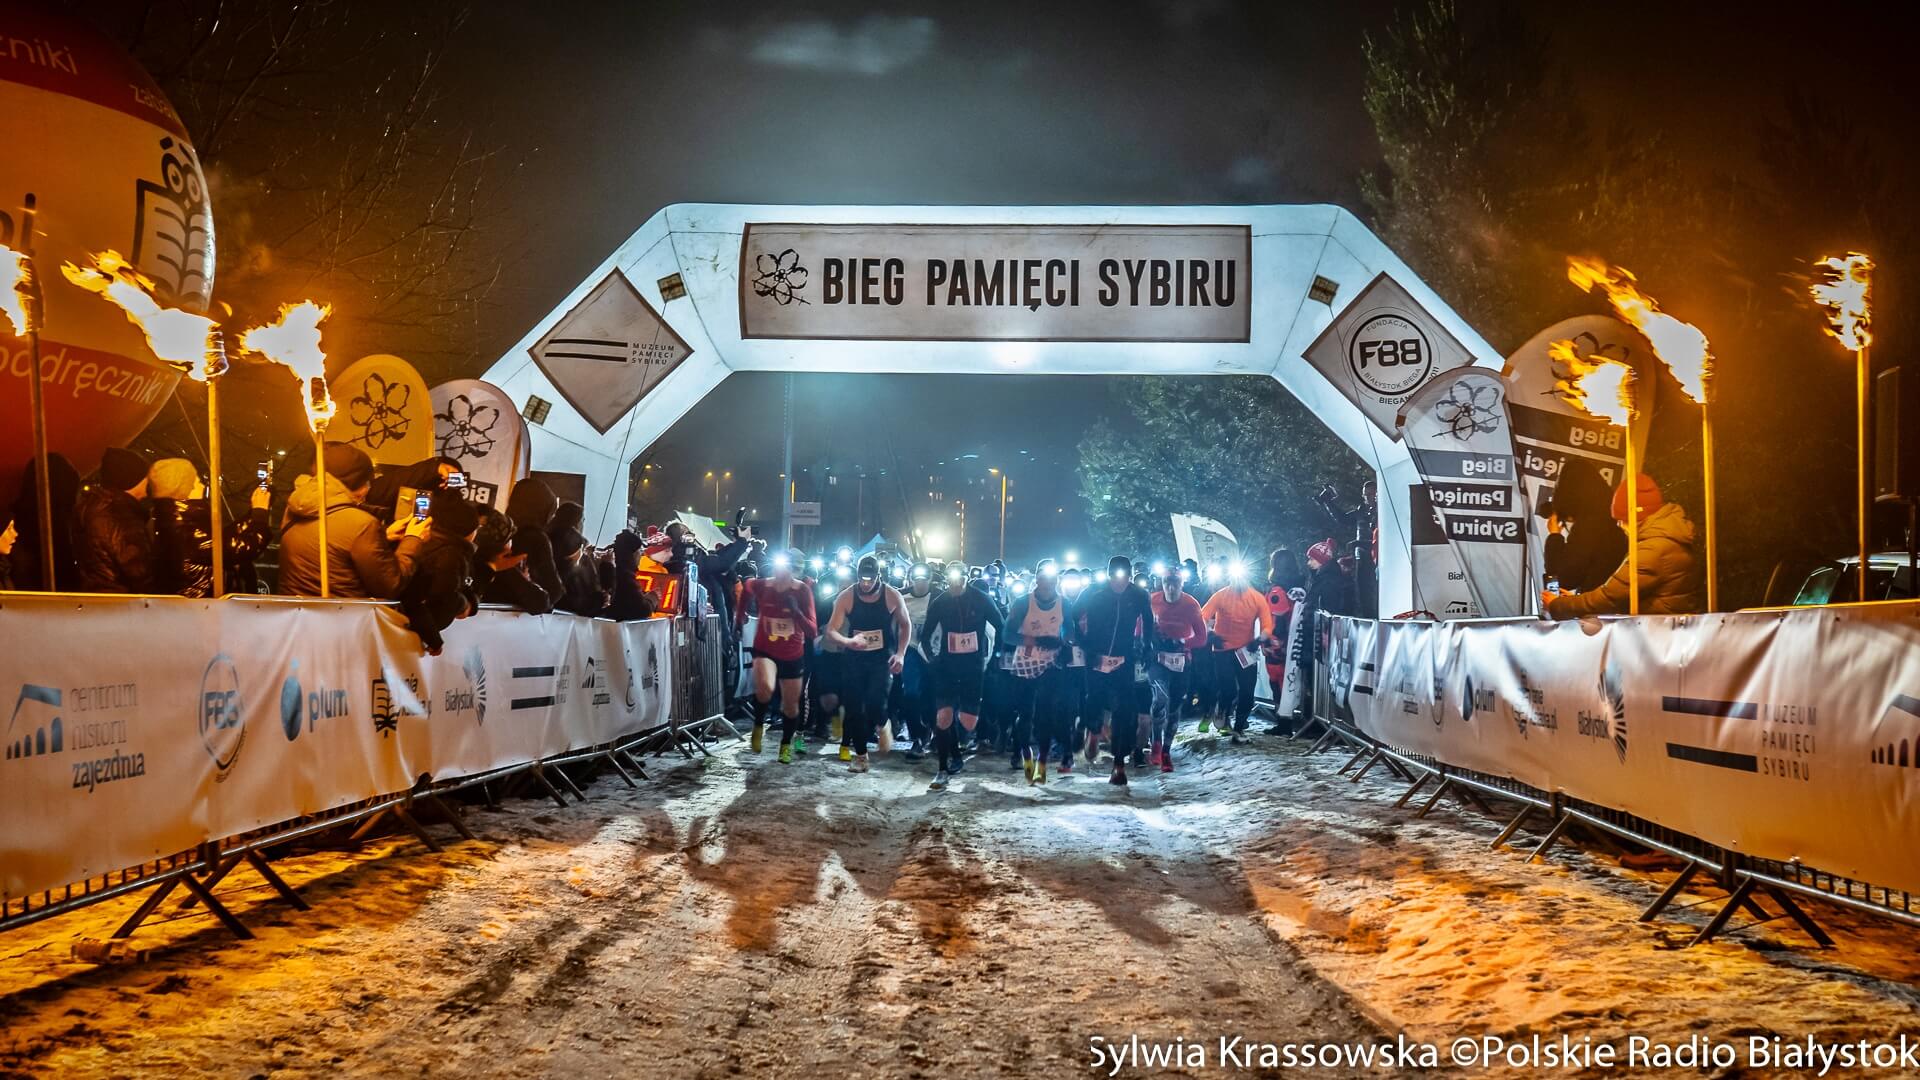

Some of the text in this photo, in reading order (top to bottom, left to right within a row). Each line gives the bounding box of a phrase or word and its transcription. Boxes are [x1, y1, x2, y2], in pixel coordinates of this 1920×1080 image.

[823, 257, 1236, 312] BIEG PAMIĘCI SYBIRU
[1365, 319, 1409, 332] FUNDACJA
[632, 343, 675, 351] MUZEUM
[1359, 339, 1422, 369] F88
[1363, 368, 1422, 391] BIAŁYSTOK BIEGA
[308, 684, 349, 733] plum
[1762, 731, 1816, 758] PAMIĘCI
[72, 748, 145, 794] zajezdnia
[1763, 757, 1810, 782] SYBIRU
